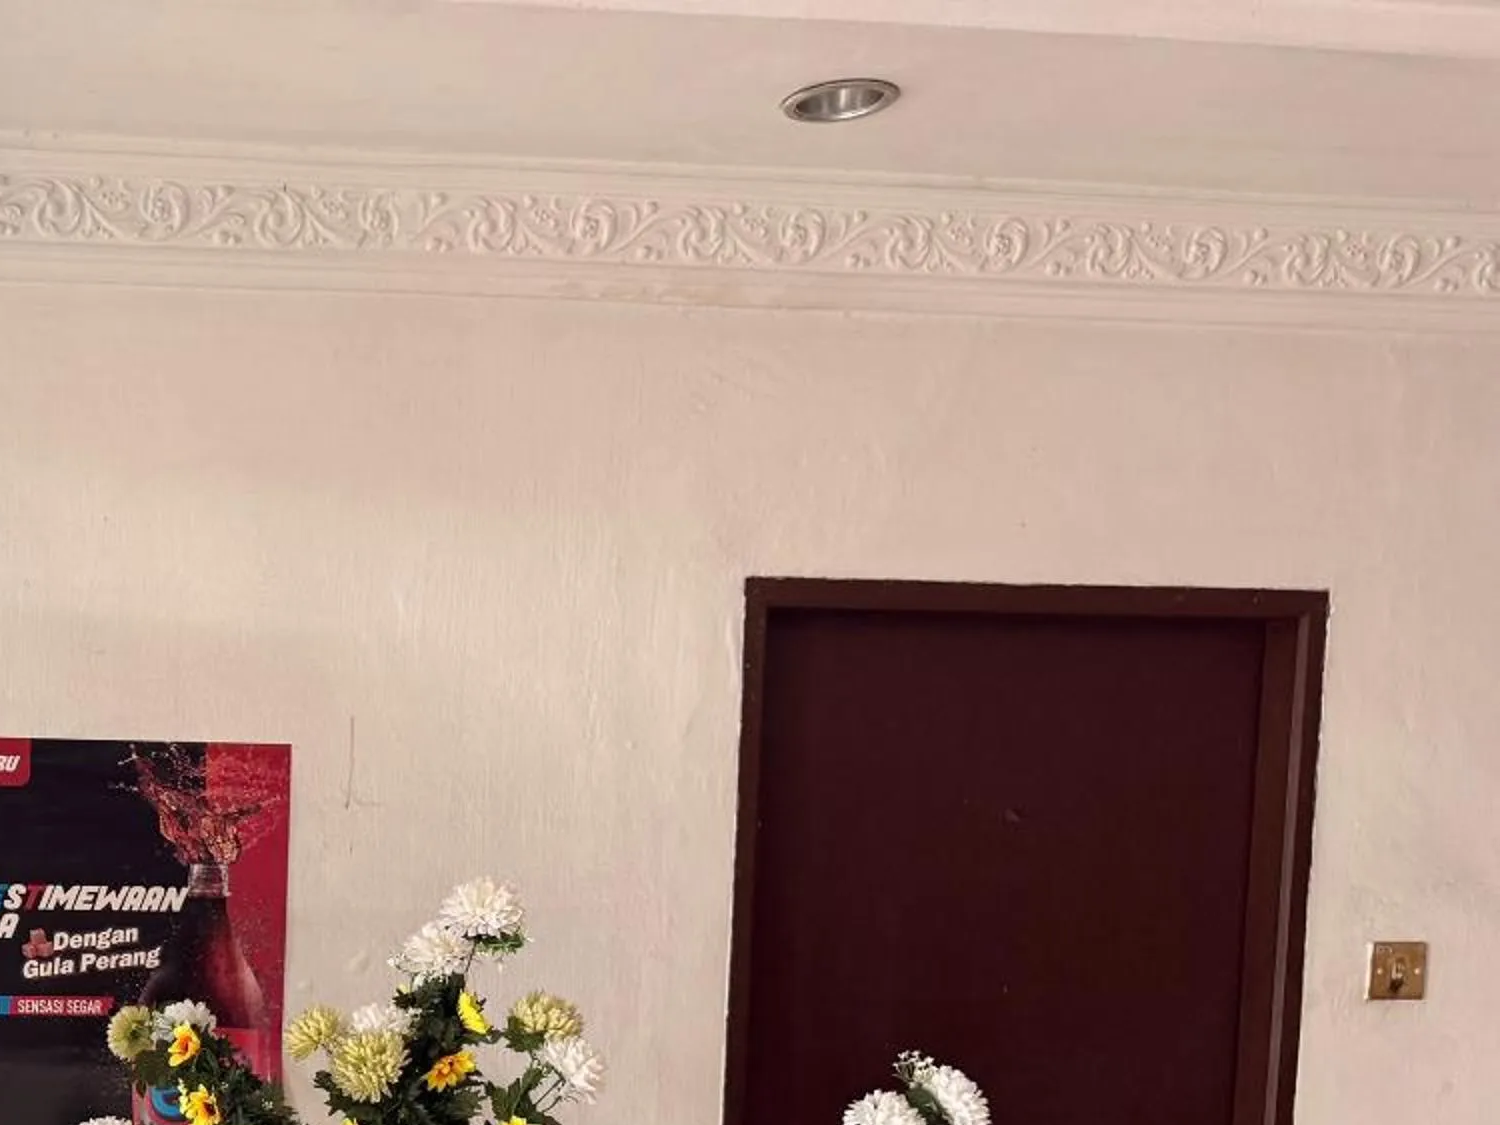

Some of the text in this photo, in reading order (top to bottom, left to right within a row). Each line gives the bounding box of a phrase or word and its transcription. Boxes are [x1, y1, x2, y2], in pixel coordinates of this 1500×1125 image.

[53, 927, 138, 951] Dengan
[23, 946, 162, 979] Gula Perang
[17, 999, 103, 1014] SENSASI SEGAR
